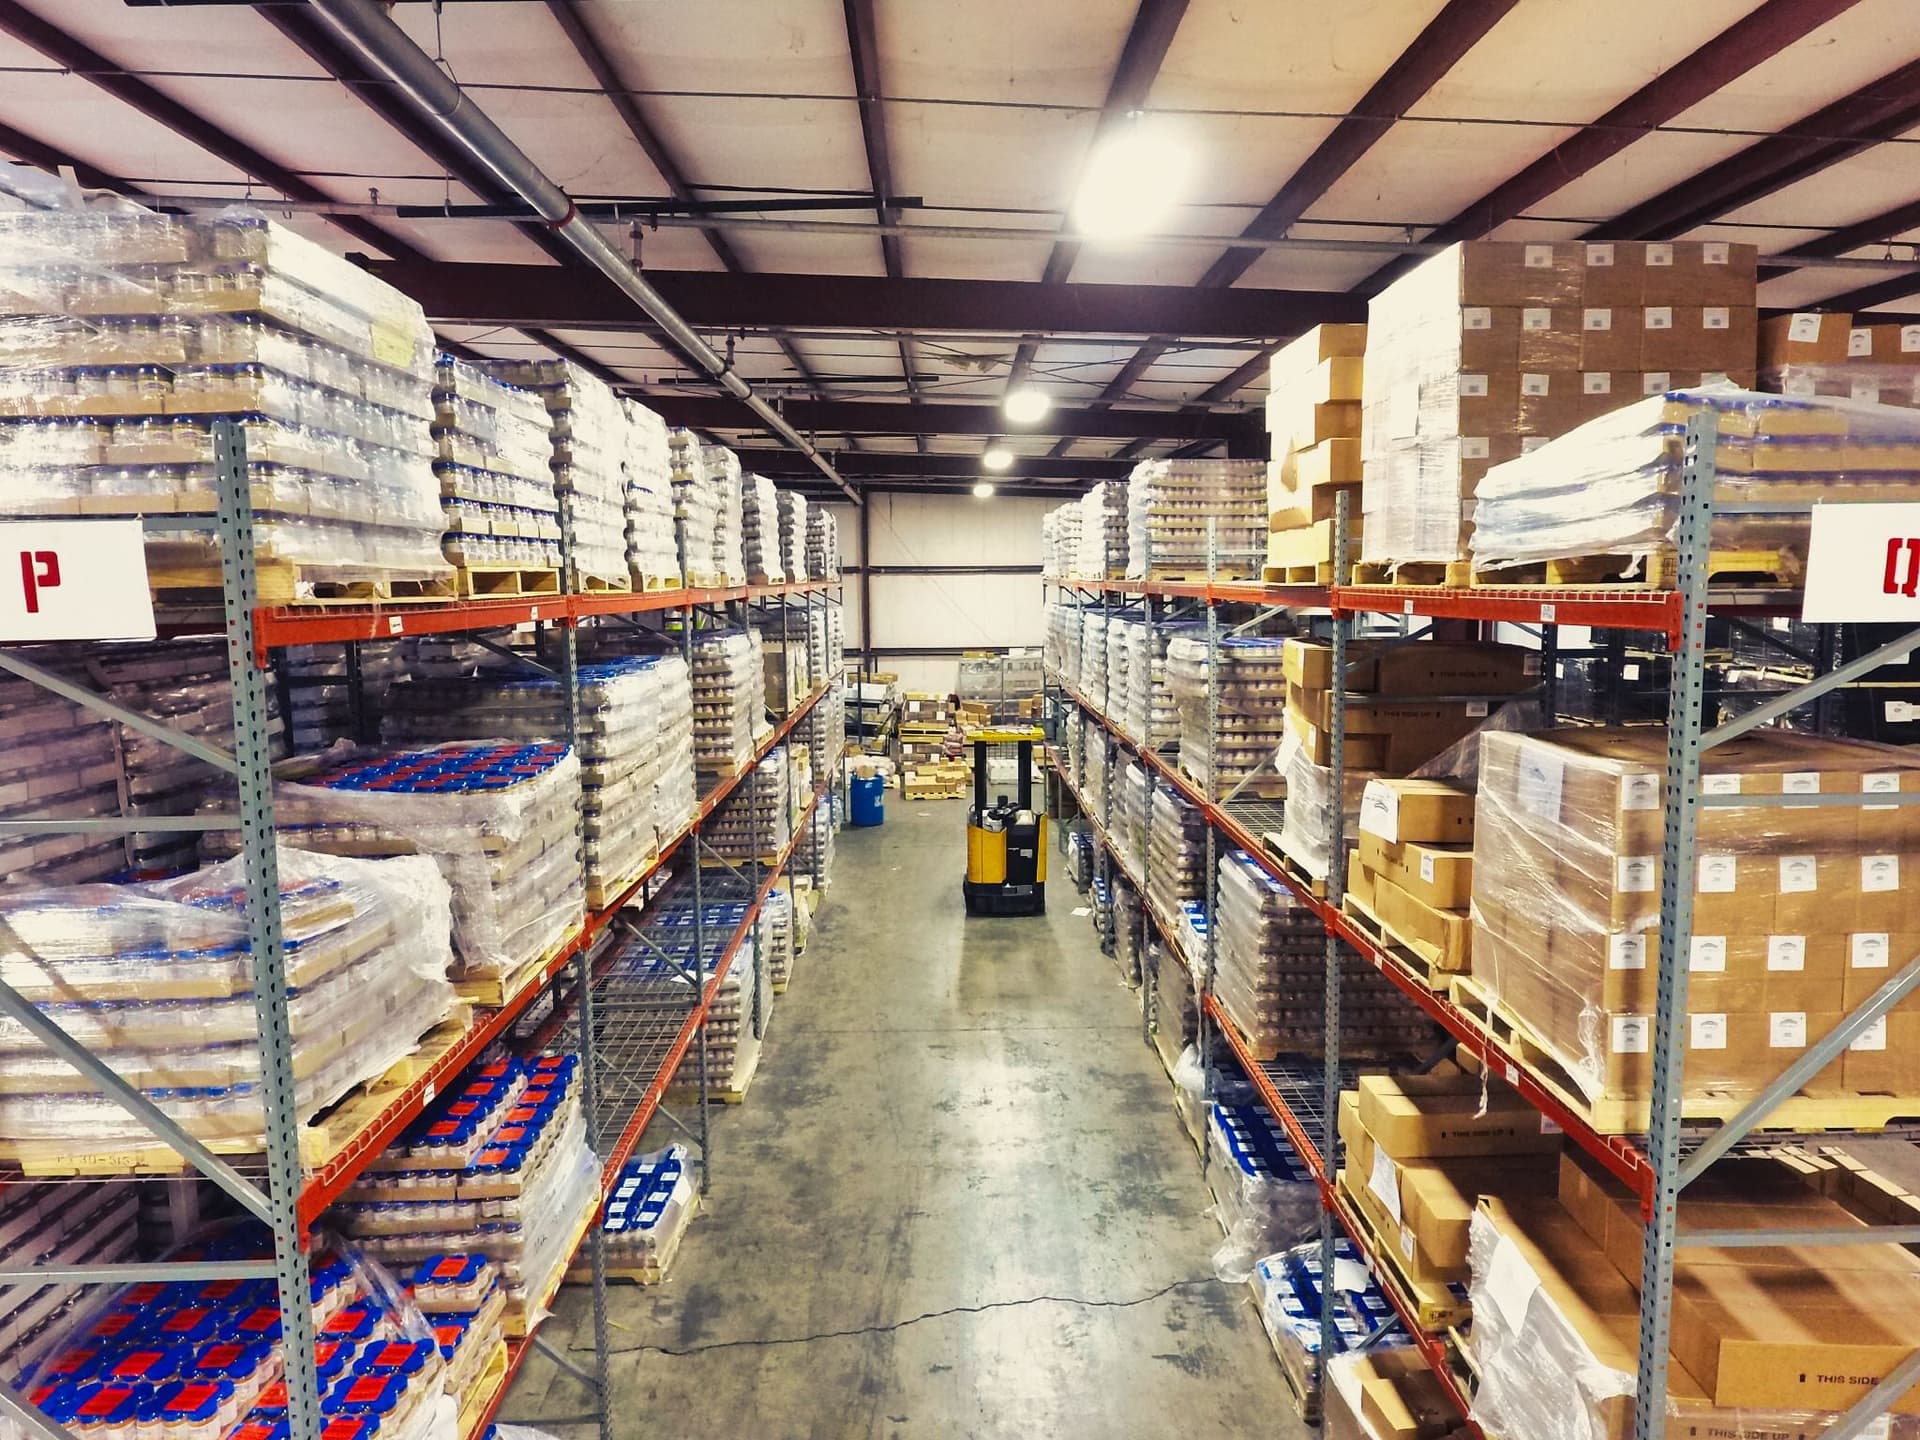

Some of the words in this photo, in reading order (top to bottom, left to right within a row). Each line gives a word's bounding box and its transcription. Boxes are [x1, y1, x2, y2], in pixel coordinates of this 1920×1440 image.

[20, 551, 61, 613] P
[1883, 538, 1920, 597] Q
[1817, 1374, 1845, 1384] THIS
[1848, 1376, 1880, 1385] SIDE
[1707, 1428, 1736, 1438] THIS
[1772, 1432, 1790, 1440] UP
